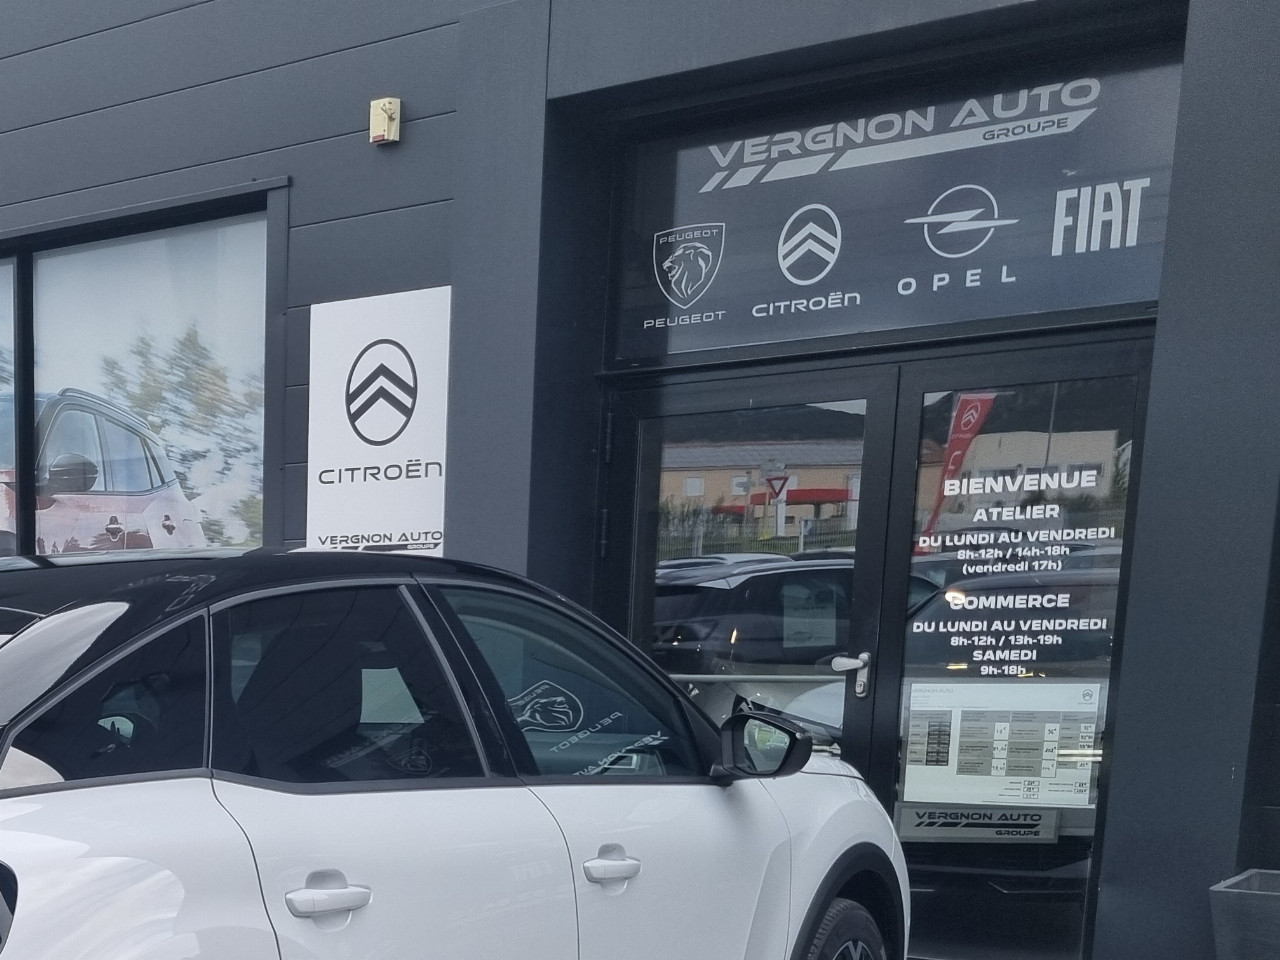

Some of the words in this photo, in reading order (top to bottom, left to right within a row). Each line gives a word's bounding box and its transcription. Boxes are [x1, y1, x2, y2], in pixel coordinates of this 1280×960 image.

[707, 105, 935, 168] VERGNON
[950, 77, 1101, 128] AUTO
[982, 117, 1069, 141] GROUPE
[1051, 177, 1151, 257] FIAT
[659, 229, 719, 245] PEUGEOT
[897, 265, 1016, 295] OPEL
[643, 311, 727, 329] PEUGEOT
[943, 470, 1097, 496] BIENVENUE
[973, 504, 1060, 522] ATELIER
[318, 533, 393, 545] VERGNON
[397, 531, 443, 543] AUTO
[919, 535, 942, 547] DU
[945, 533, 994, 546] LUNDI
[997, 531, 1023, 544] AU
[1027, 526, 1115, 542] VENDREDI
[962, 560, 1029, 575] (vendredi
[1032, 558, 1062, 572] 17h)
[949, 593, 1070, 611] COMMERCE
[913, 621, 936, 633] DU
[939, 621, 987, 632] LUNDI
[991, 620, 1016, 632] AU
[1019, 618, 1106, 631] VENDREDI
[950, 636, 996, 647] 8h-12h
[1008, 634, 1062, 646] 13h-19h
[972, 649, 1037, 661] SAMEDI
[980, 664, 1027, 676] 9h-18h
[915, 811, 993, 820] VERGNON
[996, 813, 1042, 821] AUTO
